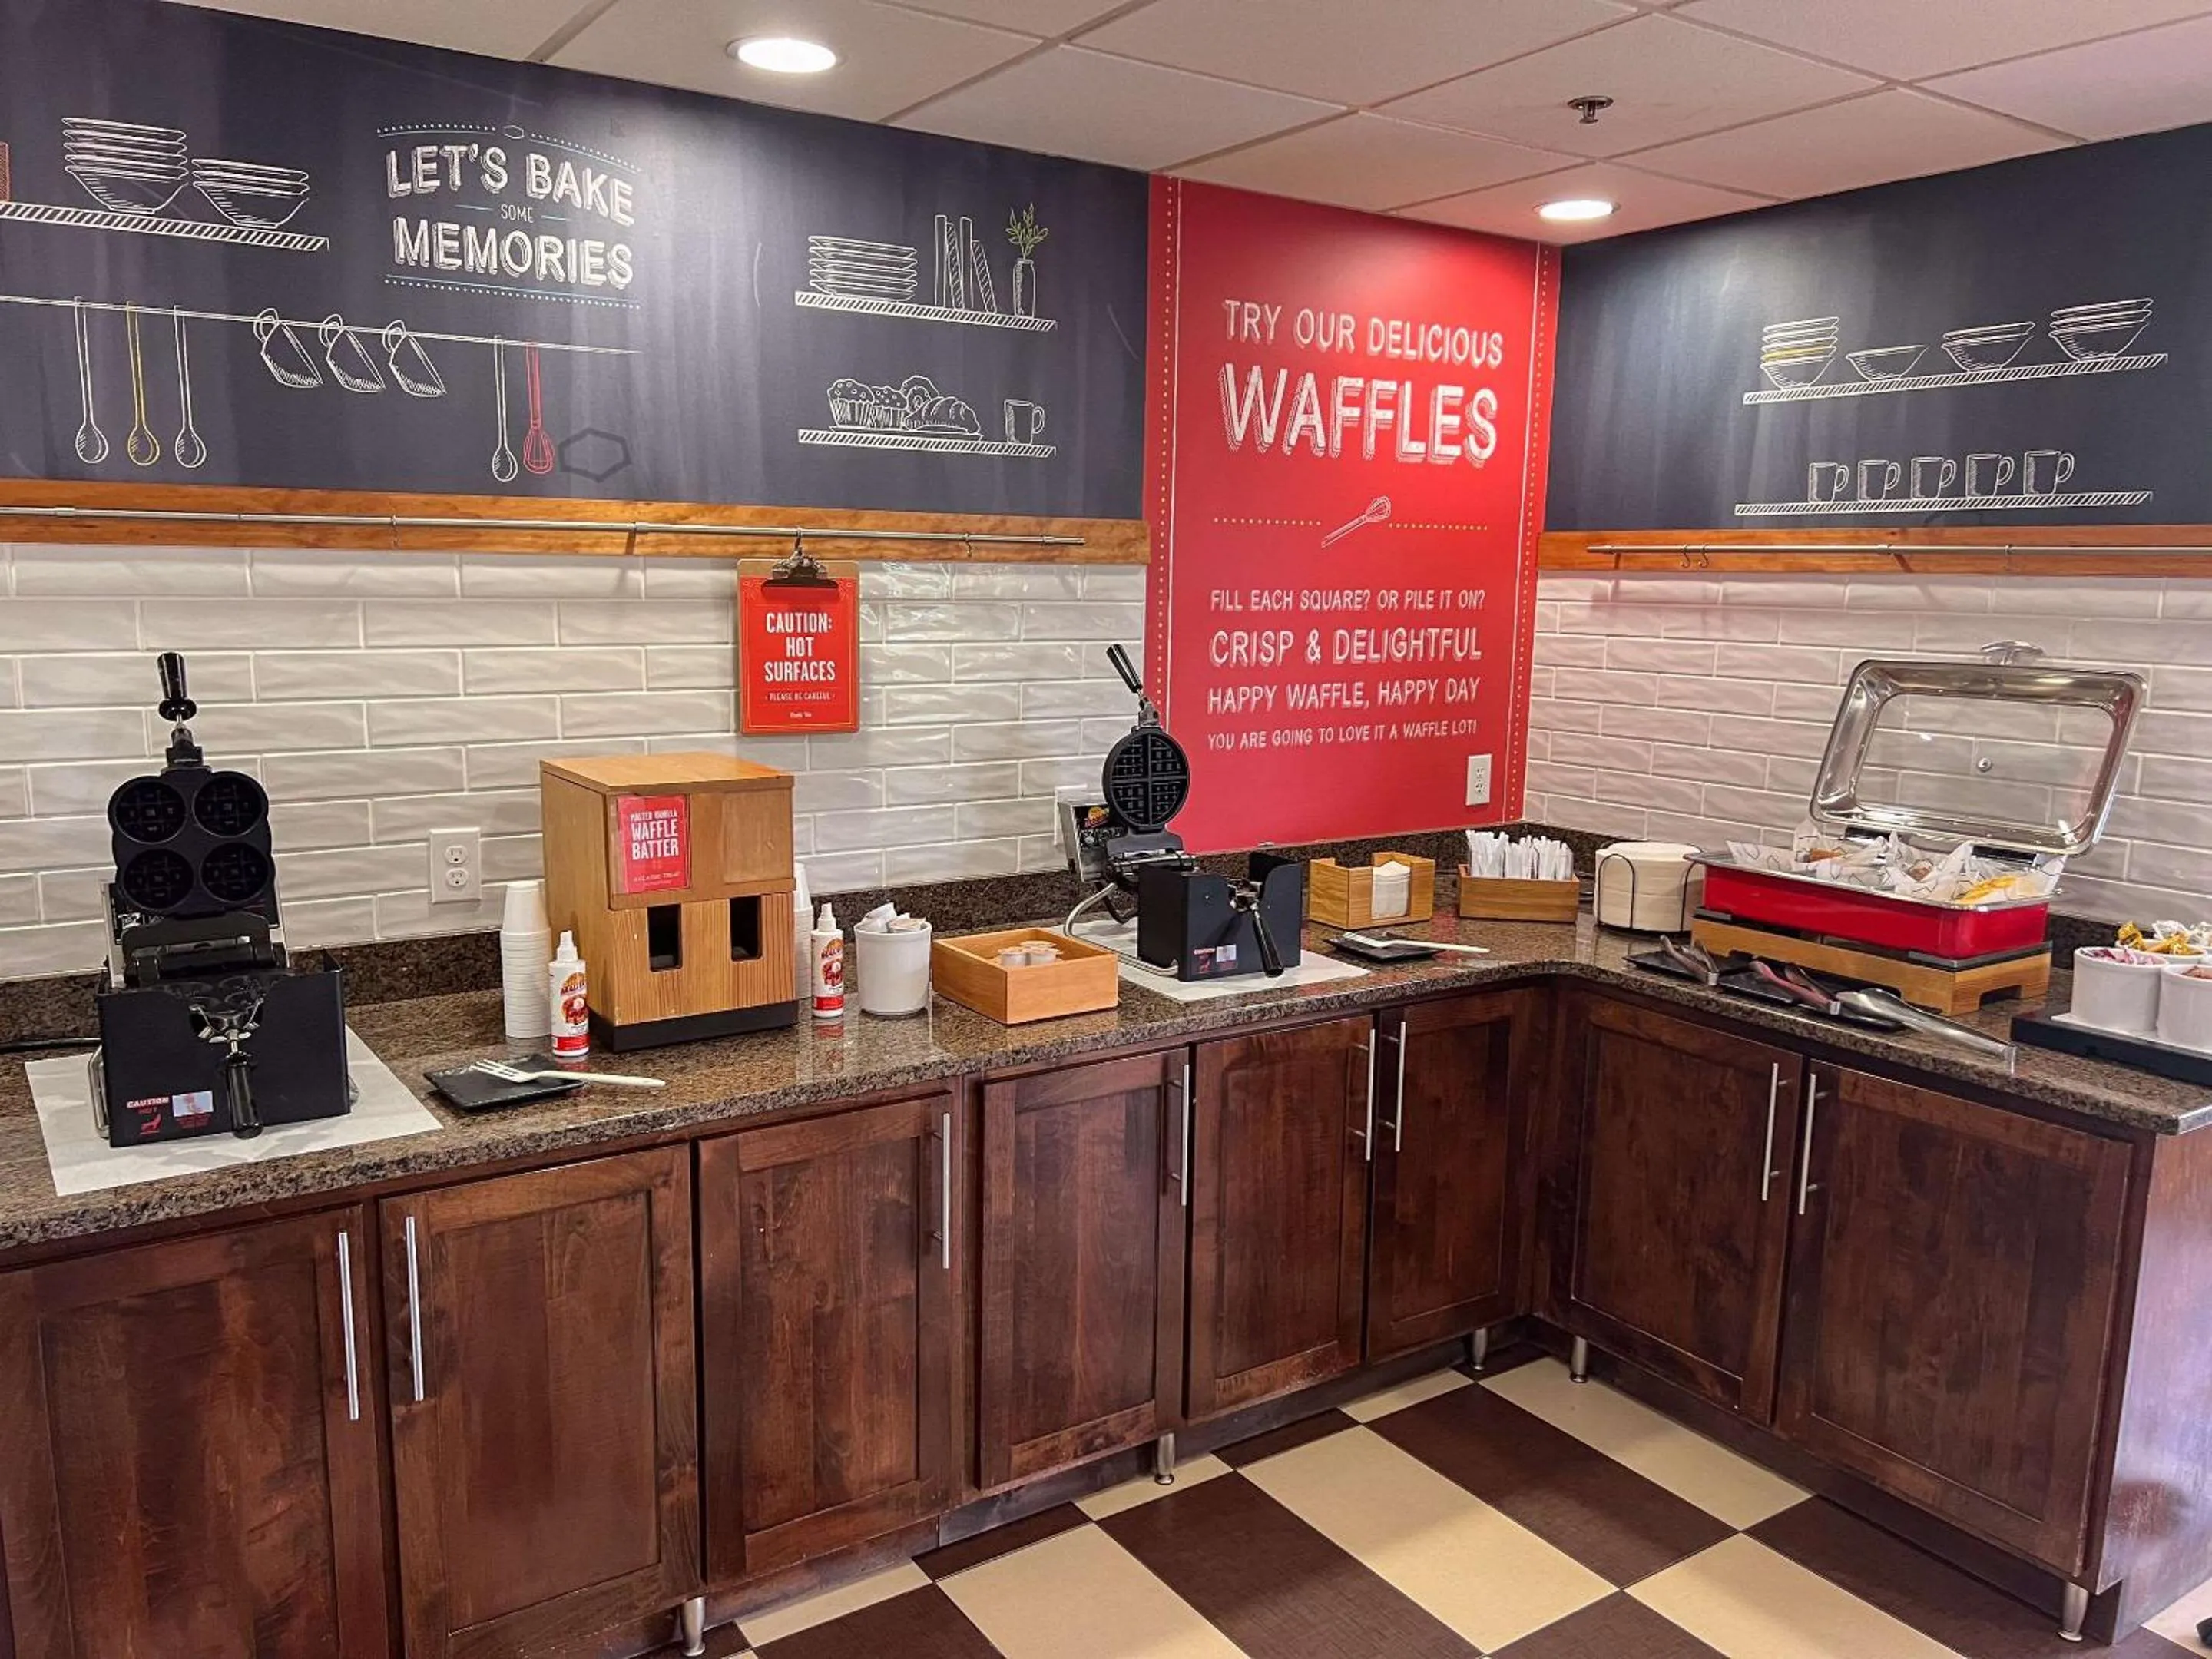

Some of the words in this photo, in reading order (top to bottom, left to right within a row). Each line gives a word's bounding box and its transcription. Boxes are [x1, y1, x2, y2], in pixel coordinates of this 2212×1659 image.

[386, 143, 508, 198] LET'S
[525, 153, 634, 227] BAKE
[500, 204, 534, 223] SOME
[393, 217, 633, 289] MEMORIES
[1224, 299, 1282, 345] TRY
[1295, 309, 1356, 354] OUR
[1367, 318, 1503, 369] DELICIOUS
[1218, 363, 1498, 467] WAFFLES
[1210, 590, 1243, 611] FILL
[1250, 589, 1293, 611] EACH
[1300, 589, 1370, 610] SQUARE?
[1377, 590, 1399, 610] OR
[1404, 590, 1433, 610] PILE
[1439, 590, 1452, 609] IT
[1458, 590, 1485, 610] ON?
[766, 612, 833, 634] CAUTION:
[786, 637, 814, 657] HOT
[1209, 630, 1294, 667] CRISP
[1306, 629, 1322, 664] &
[1333, 627, 1482, 664] DELIGHTFUL
[765, 661, 836, 682] SURFACES
[770, 693, 793, 701] PLEASE
[795, 692, 803, 700] BE
[804, 692, 830, 700] CAREFUL
[1207, 685, 1277, 714] HAPPY
[1286, 682, 1369, 710] WAFFLE,
[1377, 679, 1438, 706] HAPPY
[1445, 677, 1480, 703] DAY
[1207, 733, 1235, 750] YOU
[1240, 731, 1266, 748] ARE
[1273, 729, 1313, 746] GOING
[1319, 728, 1334, 743] TO
[1339, 725, 1369, 743] LOVE
[1374, 724, 1386, 740] IT
[1389, 723, 1397, 738] A
[1403, 720, 1448, 737] WAFFLE
[631, 819, 678, 841] WAFFLE
[632, 838, 679, 860] BATTER
[127, 1097, 169, 1108] CAUTION
